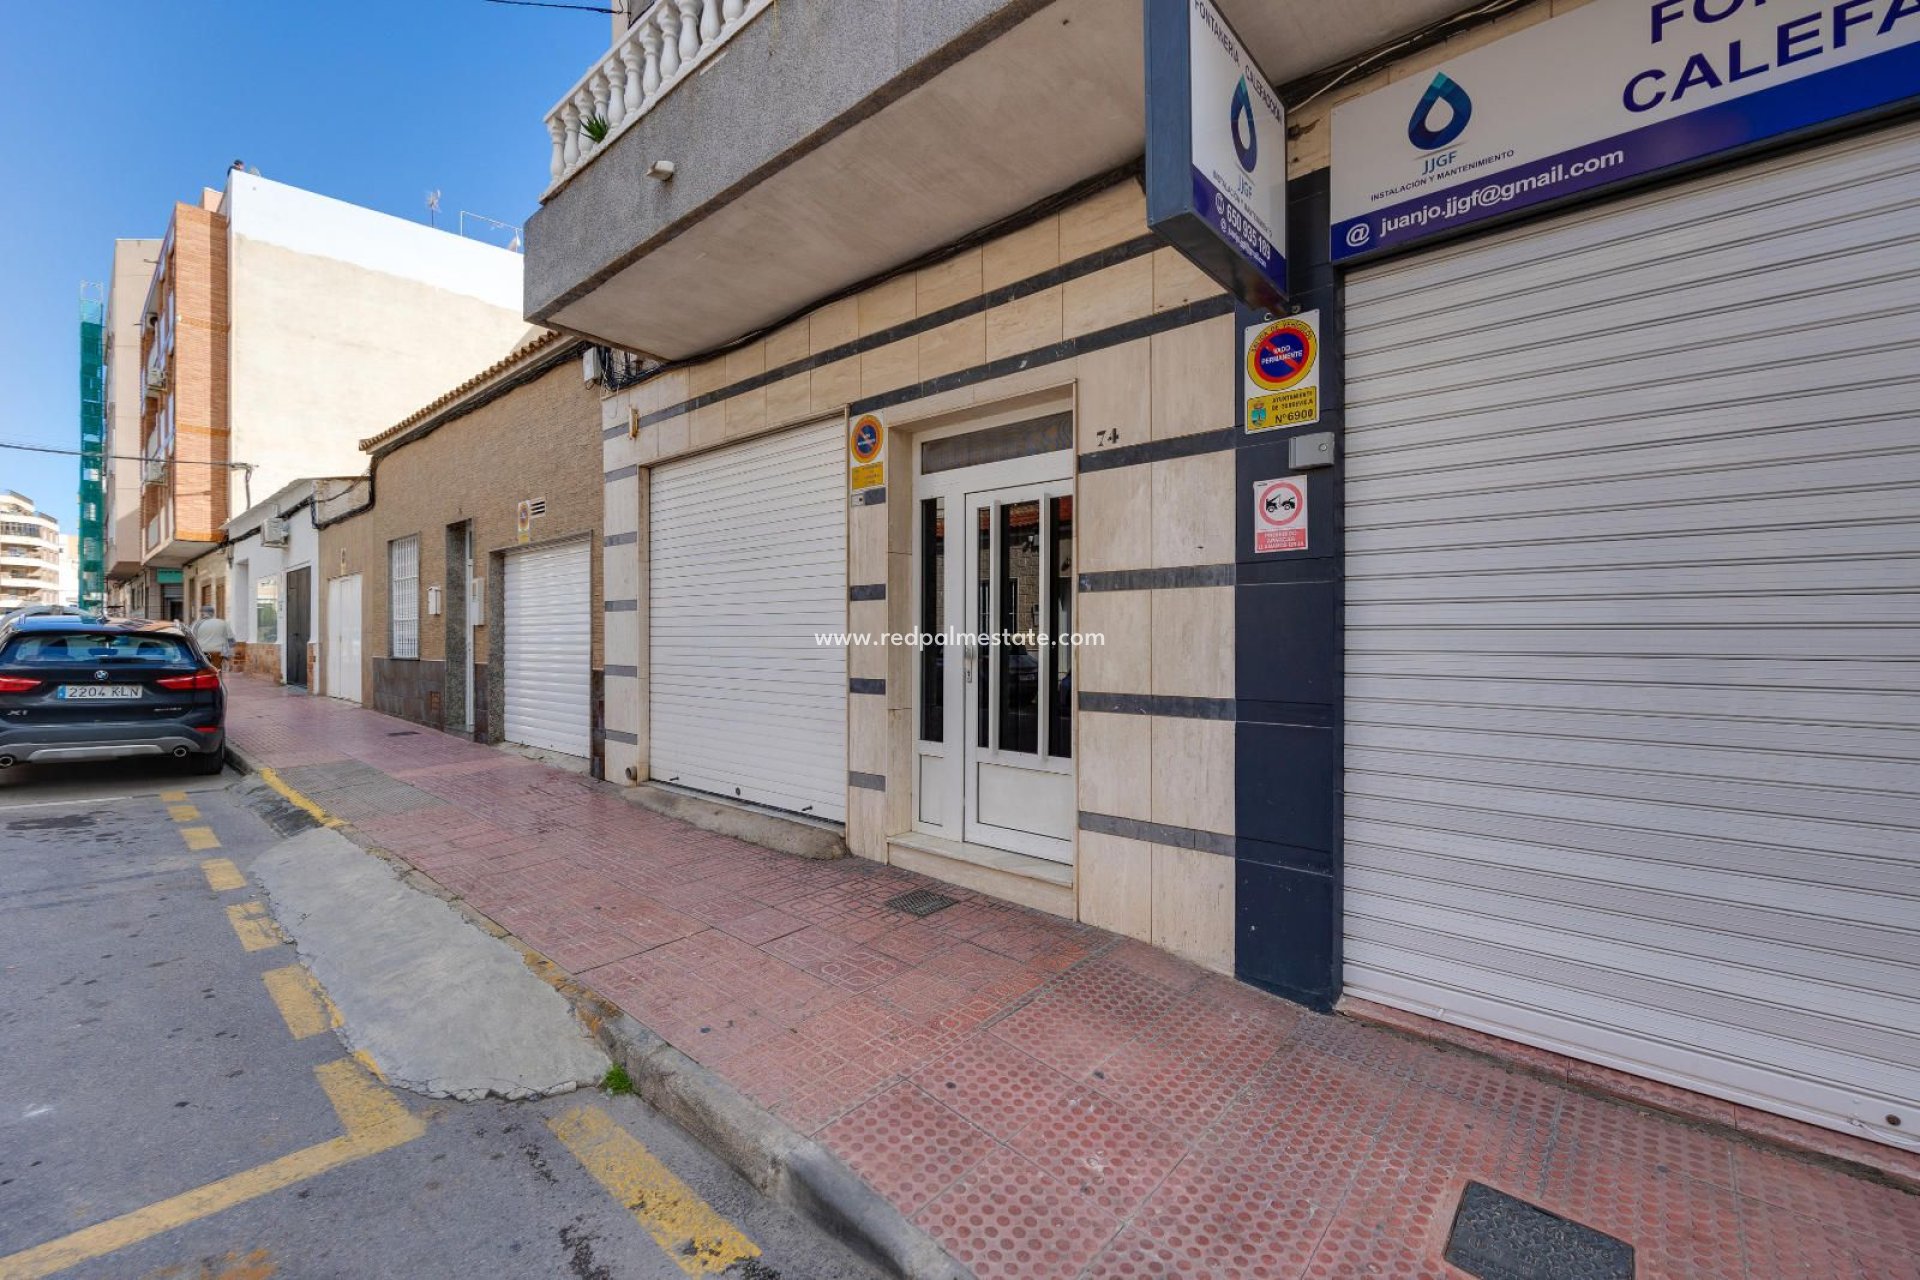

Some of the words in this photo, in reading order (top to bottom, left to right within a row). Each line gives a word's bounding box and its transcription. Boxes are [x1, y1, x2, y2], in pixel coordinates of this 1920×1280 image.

[1421, 150, 1458, 176] JJGF
[1429, 175, 1436, 184] Y
[1437, 149, 1514, 181] MANTENIMIENTO
[1380, 150, 1624, 237] juanjo.jjgf@gmail.com
[1227, 204, 1242, 232] 650
[1243, 220, 1257, 247] 935
[1096, 427, 1120, 447] 74
[69, 686, 106, 698] 2204
[111, 685, 140, 698] KLN
